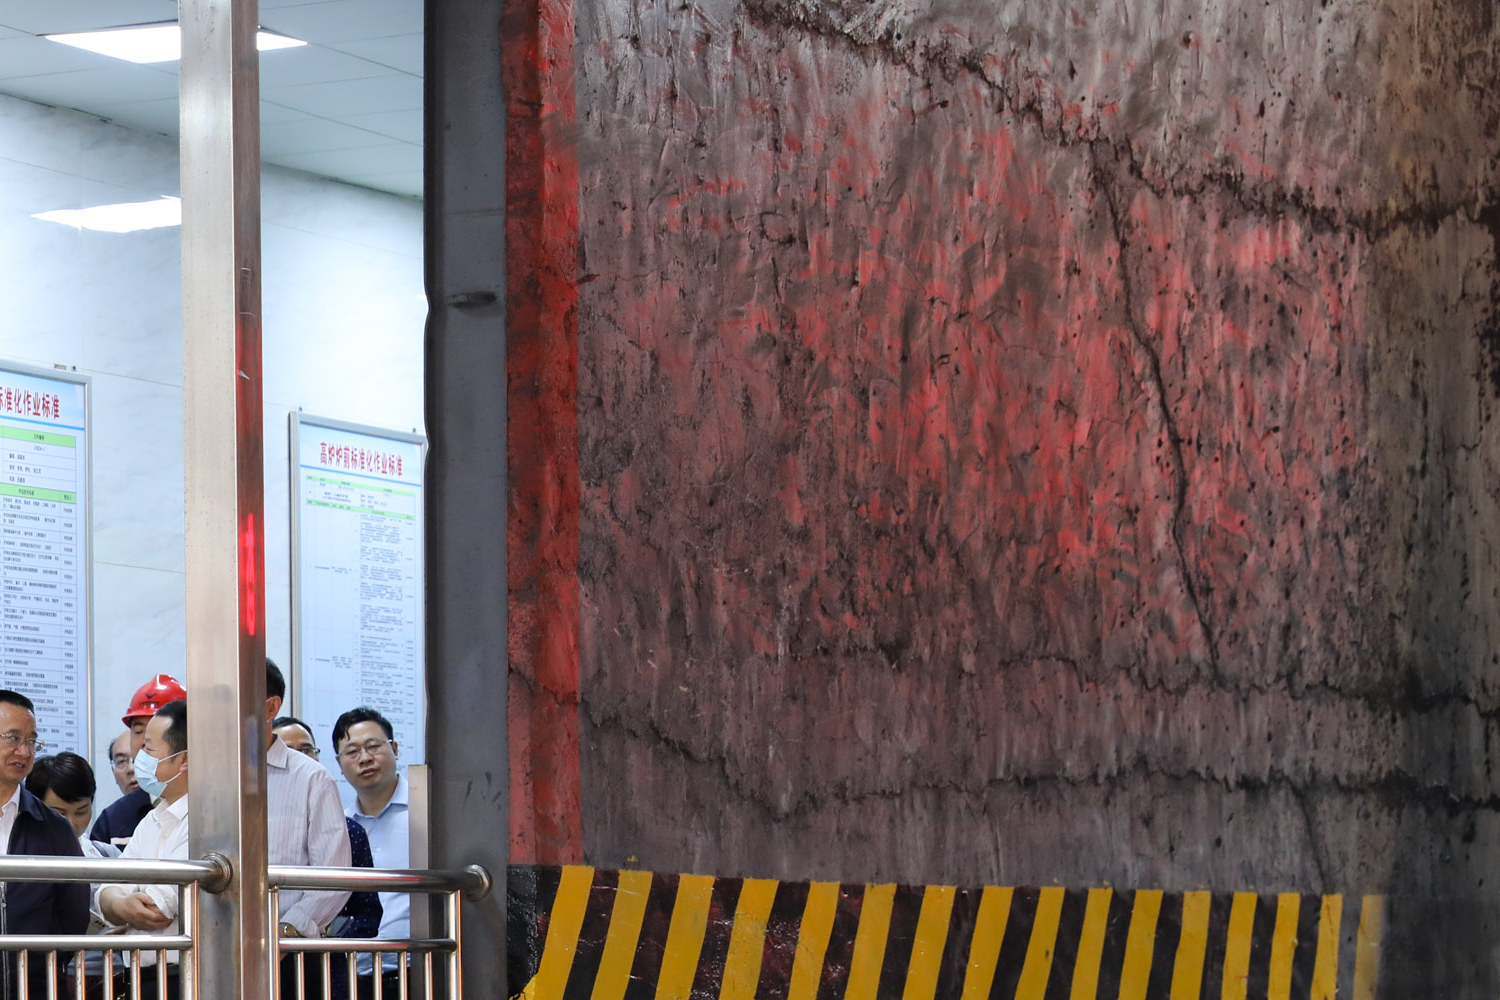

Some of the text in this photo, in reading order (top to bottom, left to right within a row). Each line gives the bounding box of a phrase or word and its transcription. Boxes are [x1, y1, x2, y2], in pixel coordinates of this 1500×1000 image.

[320, 441, 403, 476] 高炉炉前标准化作业标准
